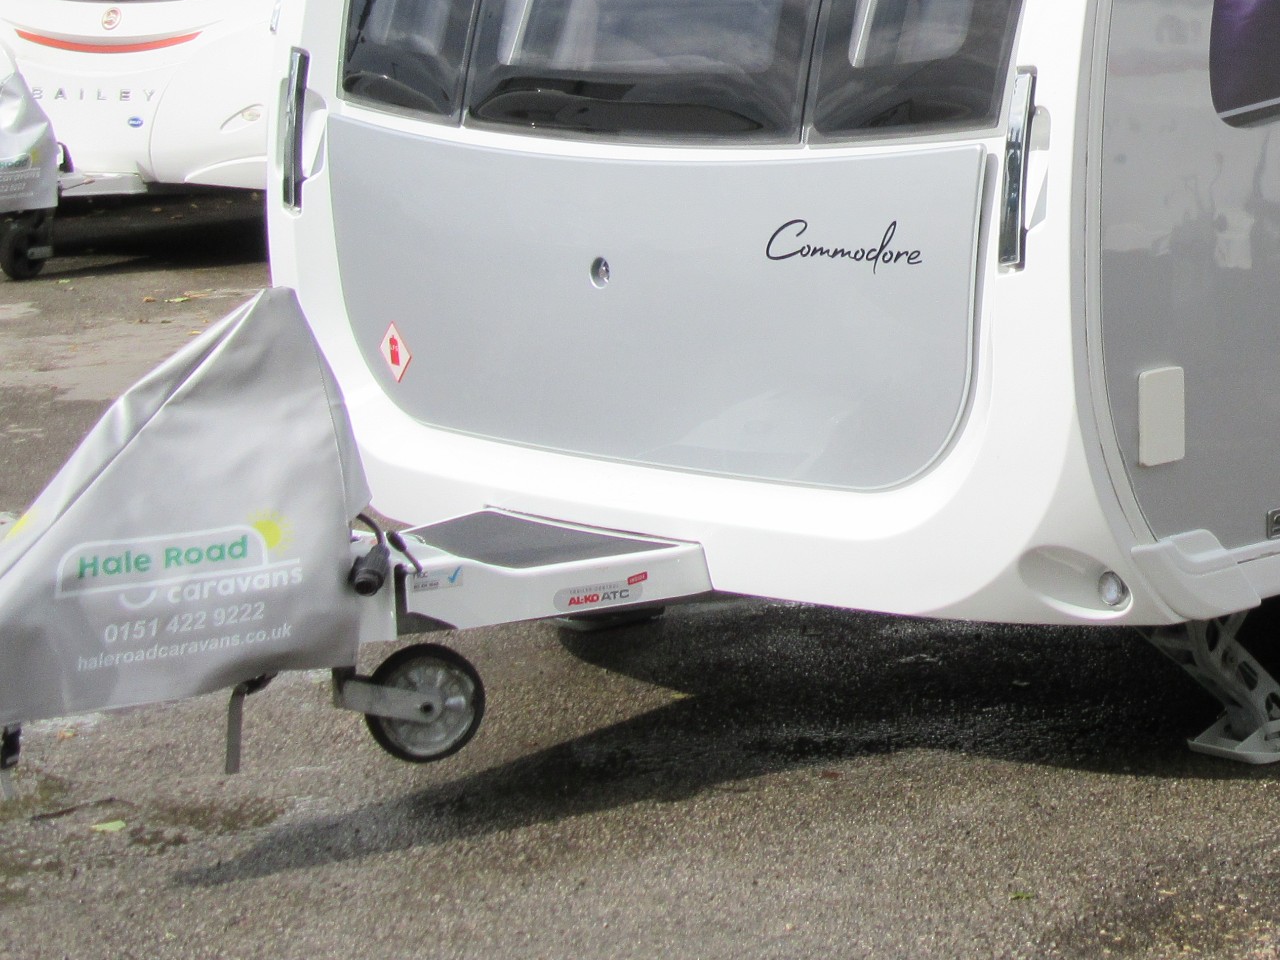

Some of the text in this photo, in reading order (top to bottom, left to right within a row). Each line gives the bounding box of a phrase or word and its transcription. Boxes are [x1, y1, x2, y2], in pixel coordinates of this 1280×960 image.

[32, 88, 155, 102] BAILEY
[766, 219, 922, 275] Commodore
[78, 535, 248, 579] Hale Road
[167, 566, 303, 604] caravans
[601, 589, 629, 602] ATC
[104, 601, 266, 643] 0151 422 9222
[78, 622, 292, 672] haleroadcaravans.co.uk
